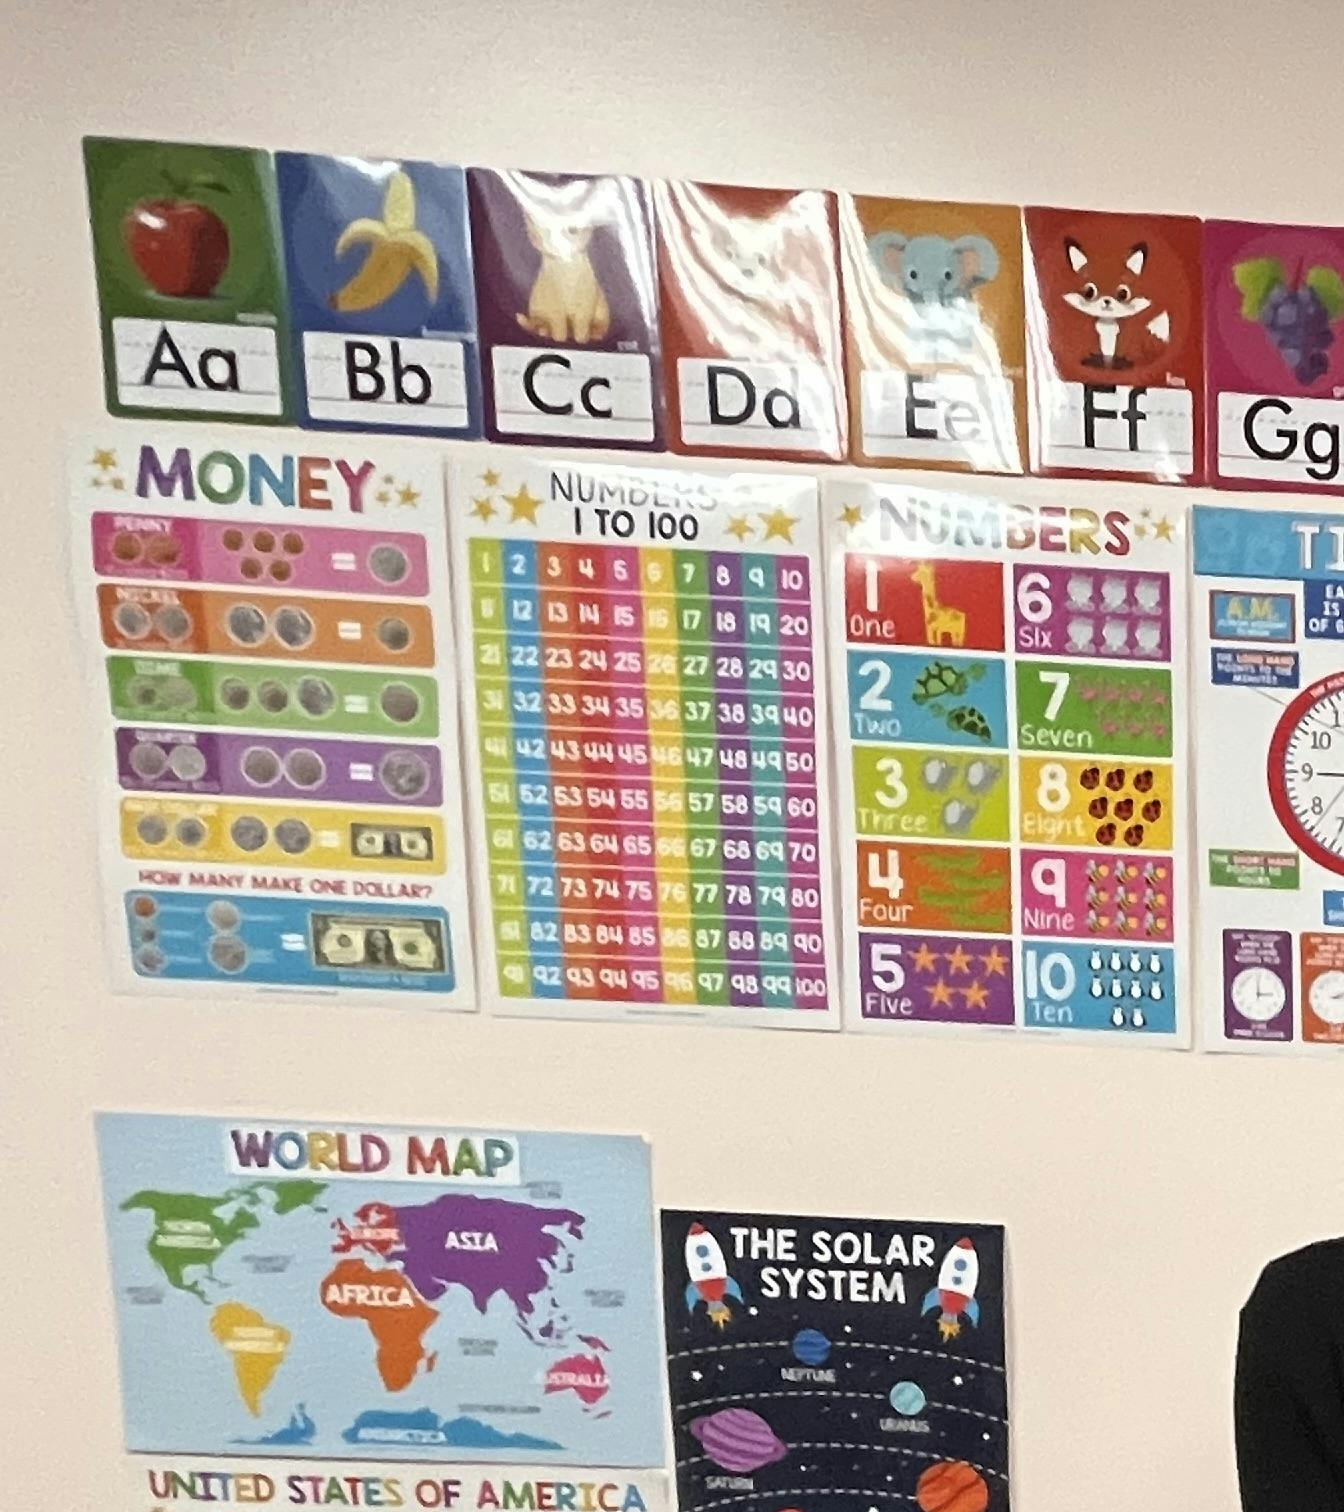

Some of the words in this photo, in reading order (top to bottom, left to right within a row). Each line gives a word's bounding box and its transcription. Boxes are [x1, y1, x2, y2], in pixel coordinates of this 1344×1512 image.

[142, 328, 239, 391] Aa
[346, 341, 433, 405] Bb
[522, 353, 613, 419] Cc
[1083, 386, 1146, 449] Ff
[1244, 399, 1339, 478] Gg
[136, 445, 375, 514] MONEY
[596, 508, 635, 539] TO
[648, 511, 699, 541] 100
[880, 498, 1131, 556] NUMBERS
[1017, 572, 1052, 624] 6
[1323, 602, 1340, 617] IS
[850, 615, 896, 640] One
[1309, 619, 1329, 633] OF
[858, 660, 893, 712] 2
[1039, 670, 1070, 721] 7
[857, 713, 901, 738] Two
[1020, 723, 1092, 749] Seven
[138, 869, 181, 886] HOW
[188, 872, 245, 889] MANY
[252, 875, 303, 893] MAKE
[310, 879, 348, 896] ONE
[869, 849, 904, 900] 4
[860, 899, 912, 922] Four
[870, 944, 906, 994] 5
[1026, 950, 1076, 1002] 10
[1034, 1002, 1073, 1025] Ten
[231, 1129, 391, 1172] WORLD
[407, 1136, 513, 1176] MAP
[445, 1231, 498, 1252] ASIA
[730, 1228, 797, 1261] THE
[812, 1232, 936, 1267] SOLAR
[325, 1284, 416, 1308] AFRICA
[760, 1268, 906, 1304] SYSTEM
[148, 1470, 276, 1503] UNITED
[288, 1475, 402, 1506] STATES
[416, 1479, 461, 1508] OF
